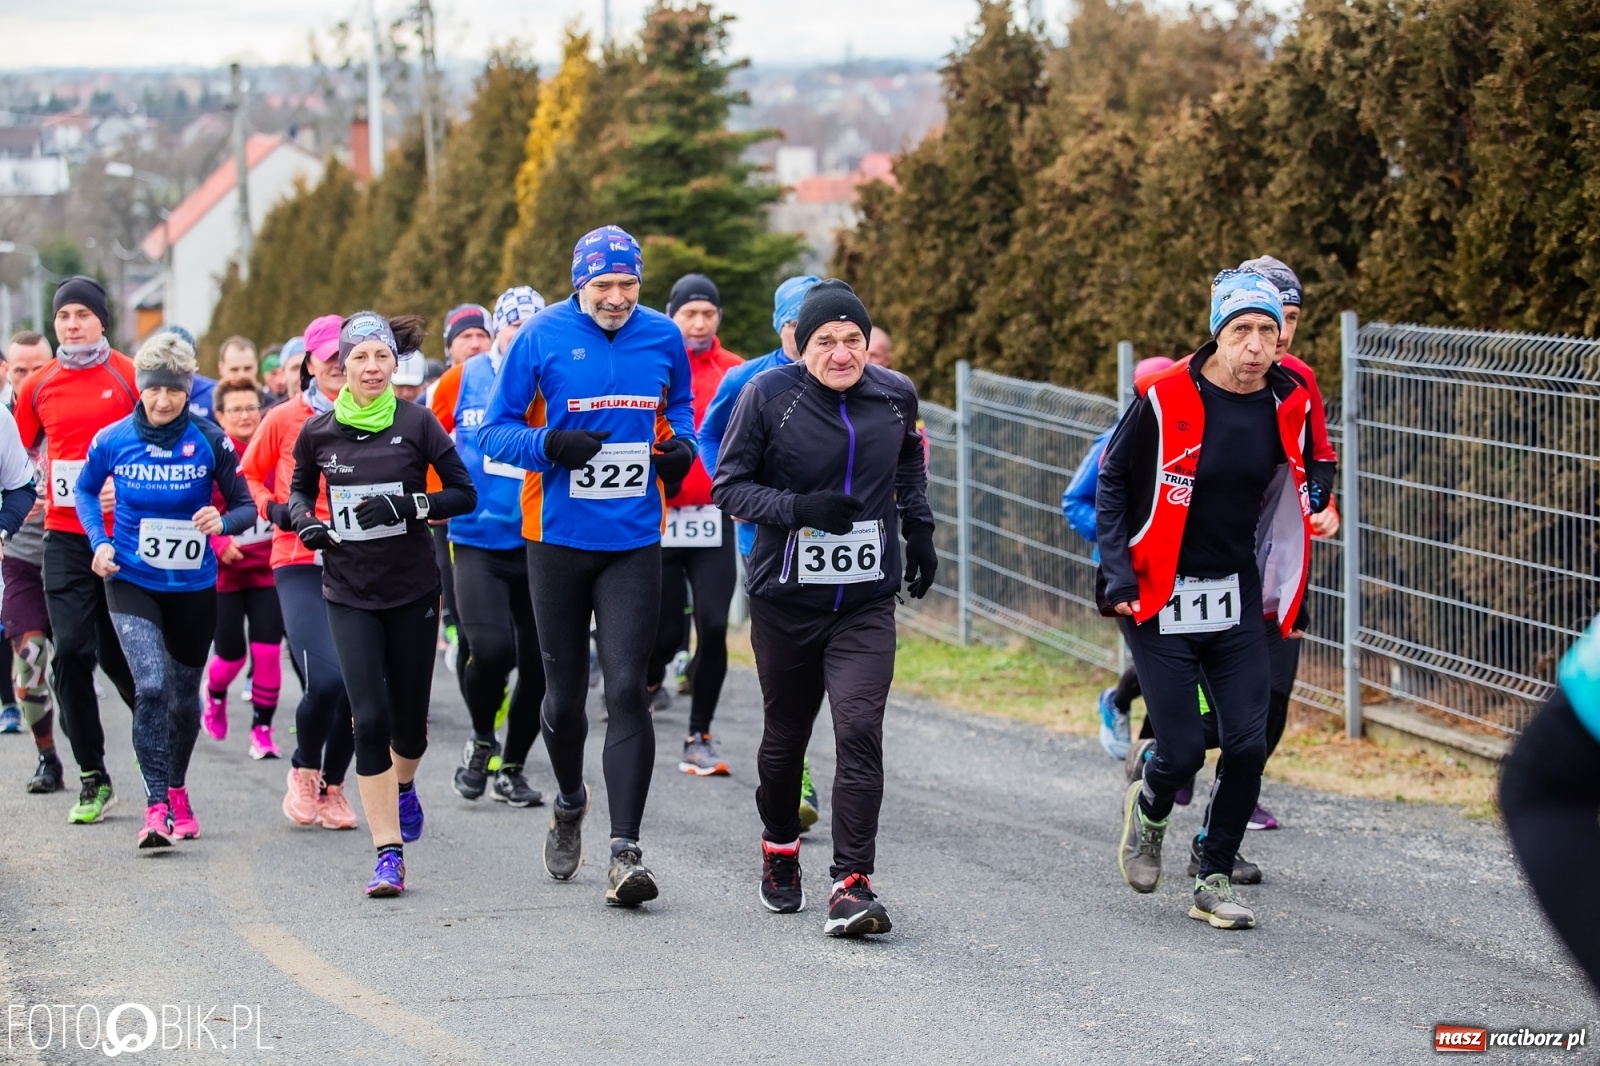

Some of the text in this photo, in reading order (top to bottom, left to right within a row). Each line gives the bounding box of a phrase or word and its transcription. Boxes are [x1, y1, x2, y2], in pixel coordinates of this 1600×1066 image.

[590, 399, 657, 409] HELUKABEL
[169, 481, 192, 491] TEAM
[575, 463, 645, 489] 322
[667, 520, 717, 538] 159
[143, 537, 201, 560] 370
[804, 543, 877, 573] 366
[1166, 591, 1232, 622] 111
